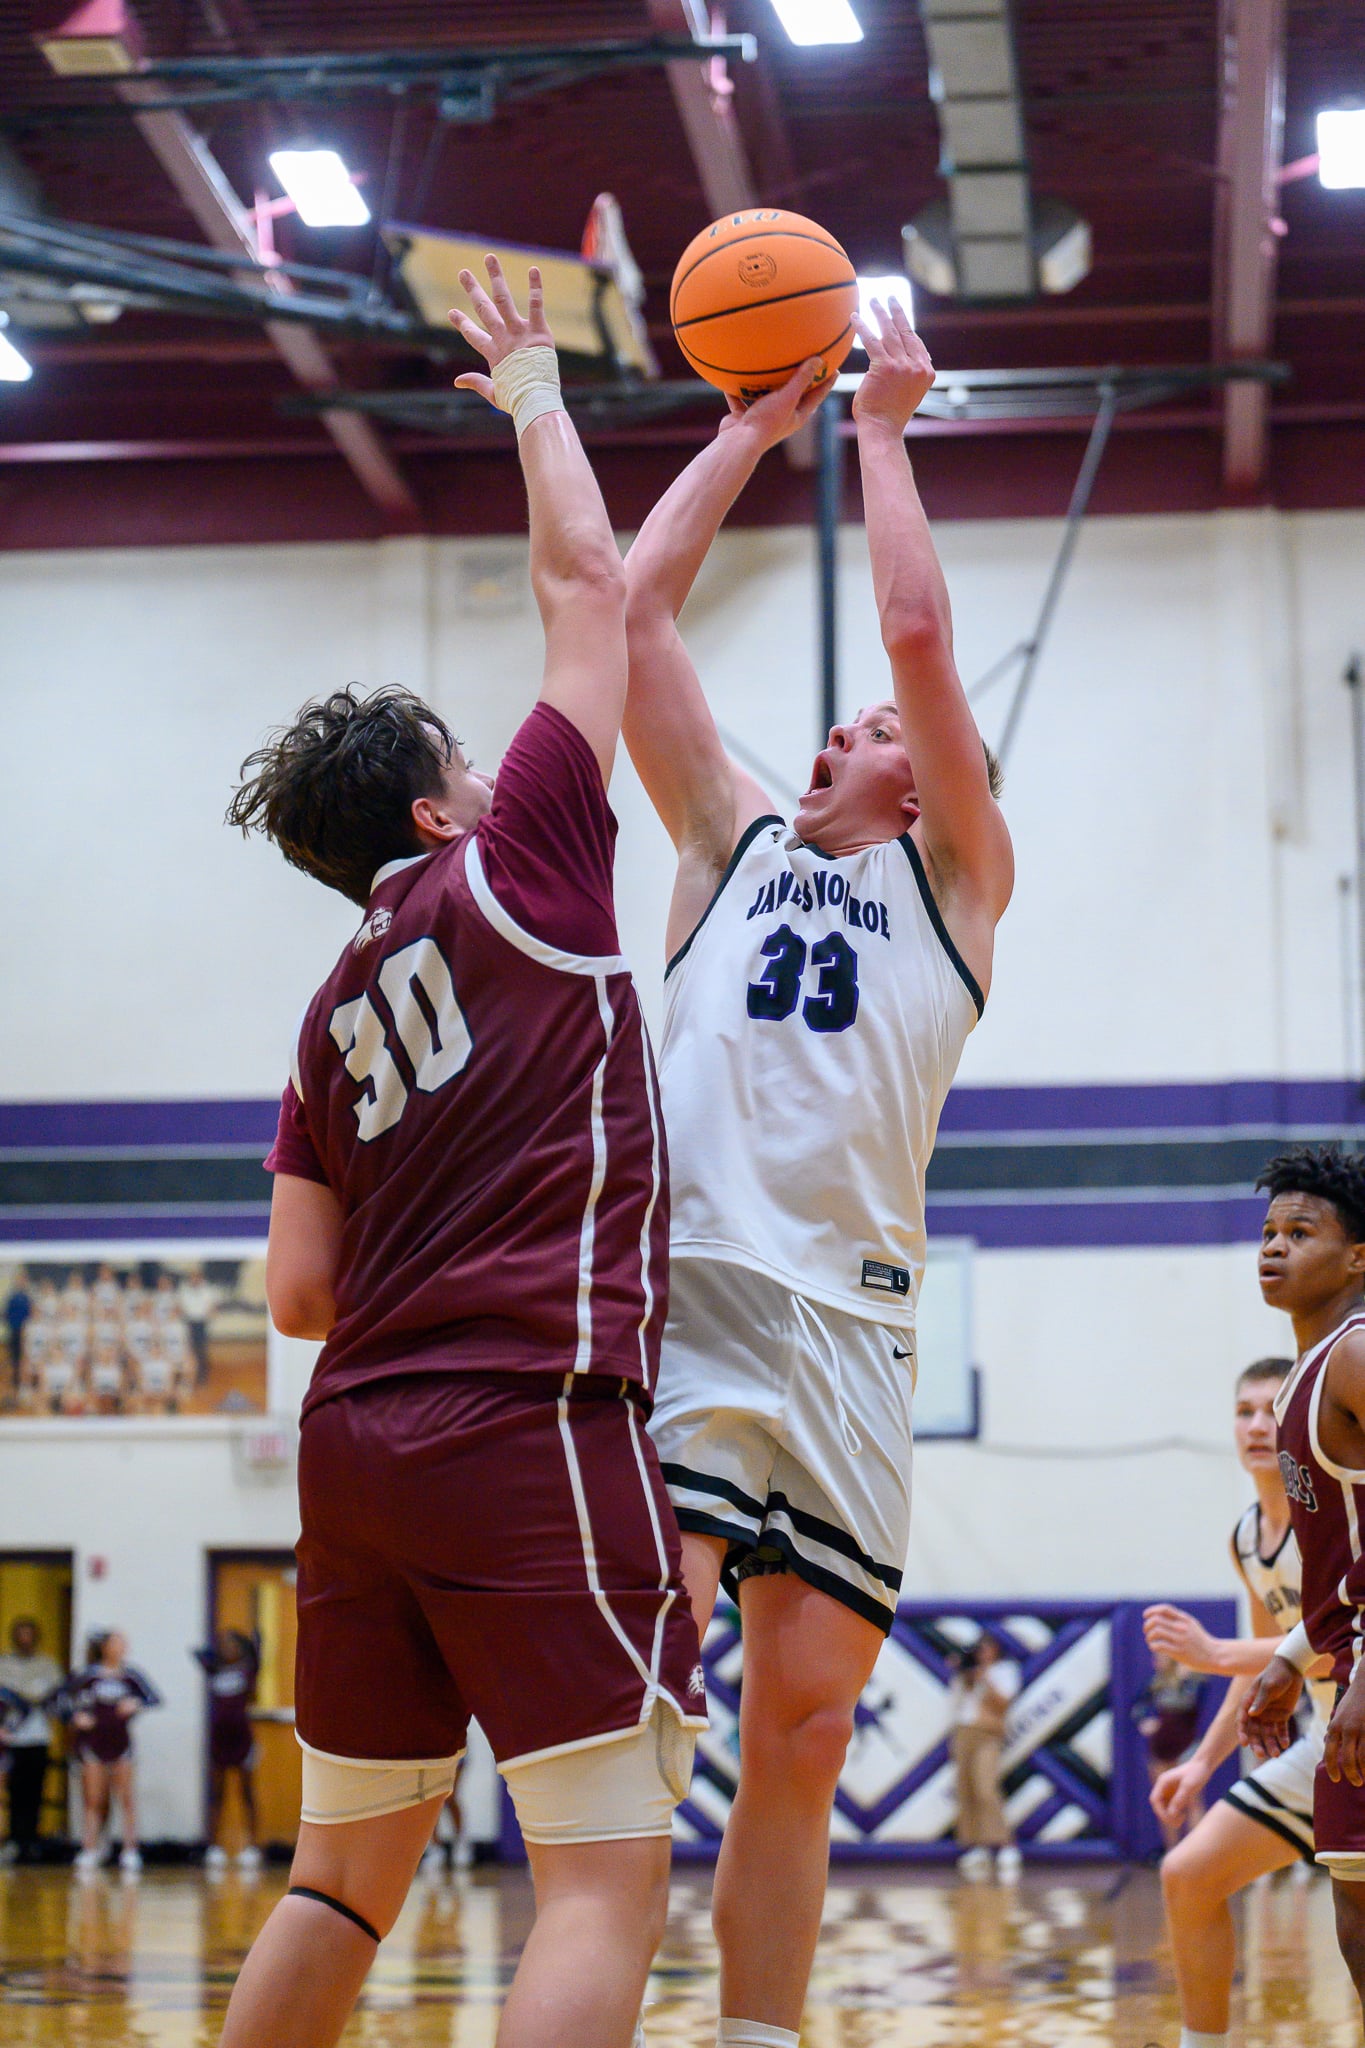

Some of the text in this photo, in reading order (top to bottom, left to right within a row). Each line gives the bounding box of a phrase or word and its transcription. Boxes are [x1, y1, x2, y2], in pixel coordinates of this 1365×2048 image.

[746, 923, 859, 1033] 33
[327, 935, 475, 1144] 30
[898, 1275, 904, 1286] L
